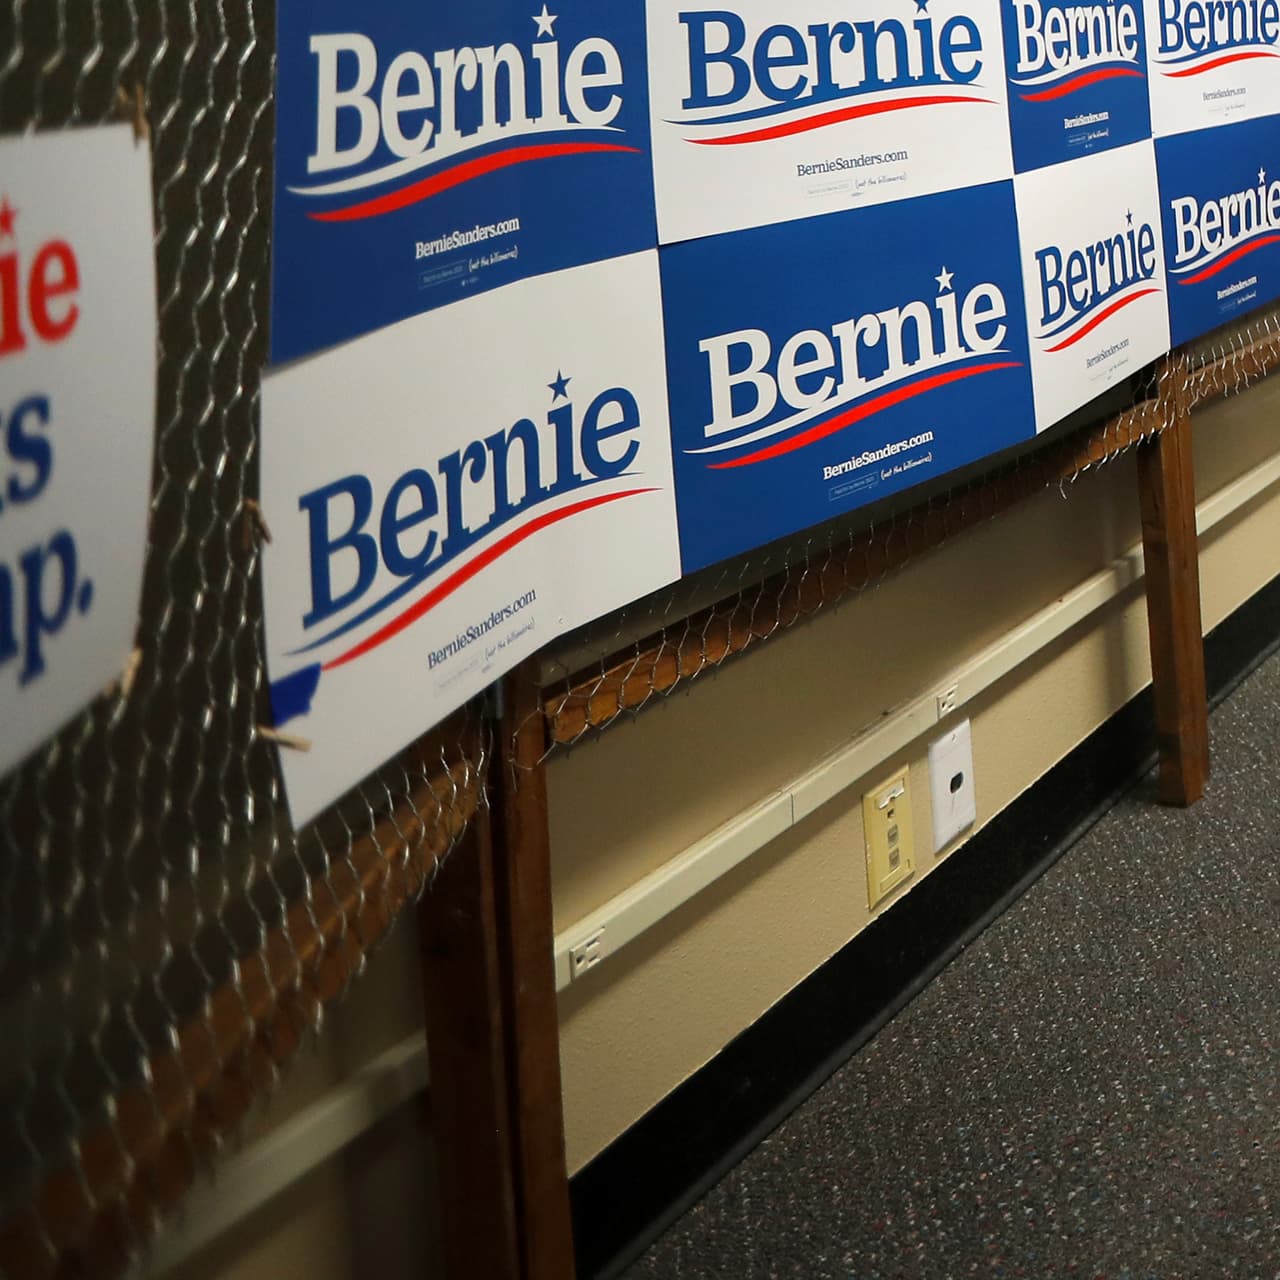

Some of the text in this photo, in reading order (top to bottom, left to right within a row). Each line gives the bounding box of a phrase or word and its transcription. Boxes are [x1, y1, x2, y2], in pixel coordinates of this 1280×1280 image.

[307, 4, 623, 174] Bernie
[797, 150, 908, 176] BernieSanders.com
[415, 218, 520, 259] BernieSanders.com
[1035, 208, 1155, 326] Bernie
[699, 266, 1007, 438] Bernie
[299, 370, 640, 630] Bernie
[823, 431, 934, 480] BernieSanders.com
[427, 589, 537, 669] BernieSanders.com
